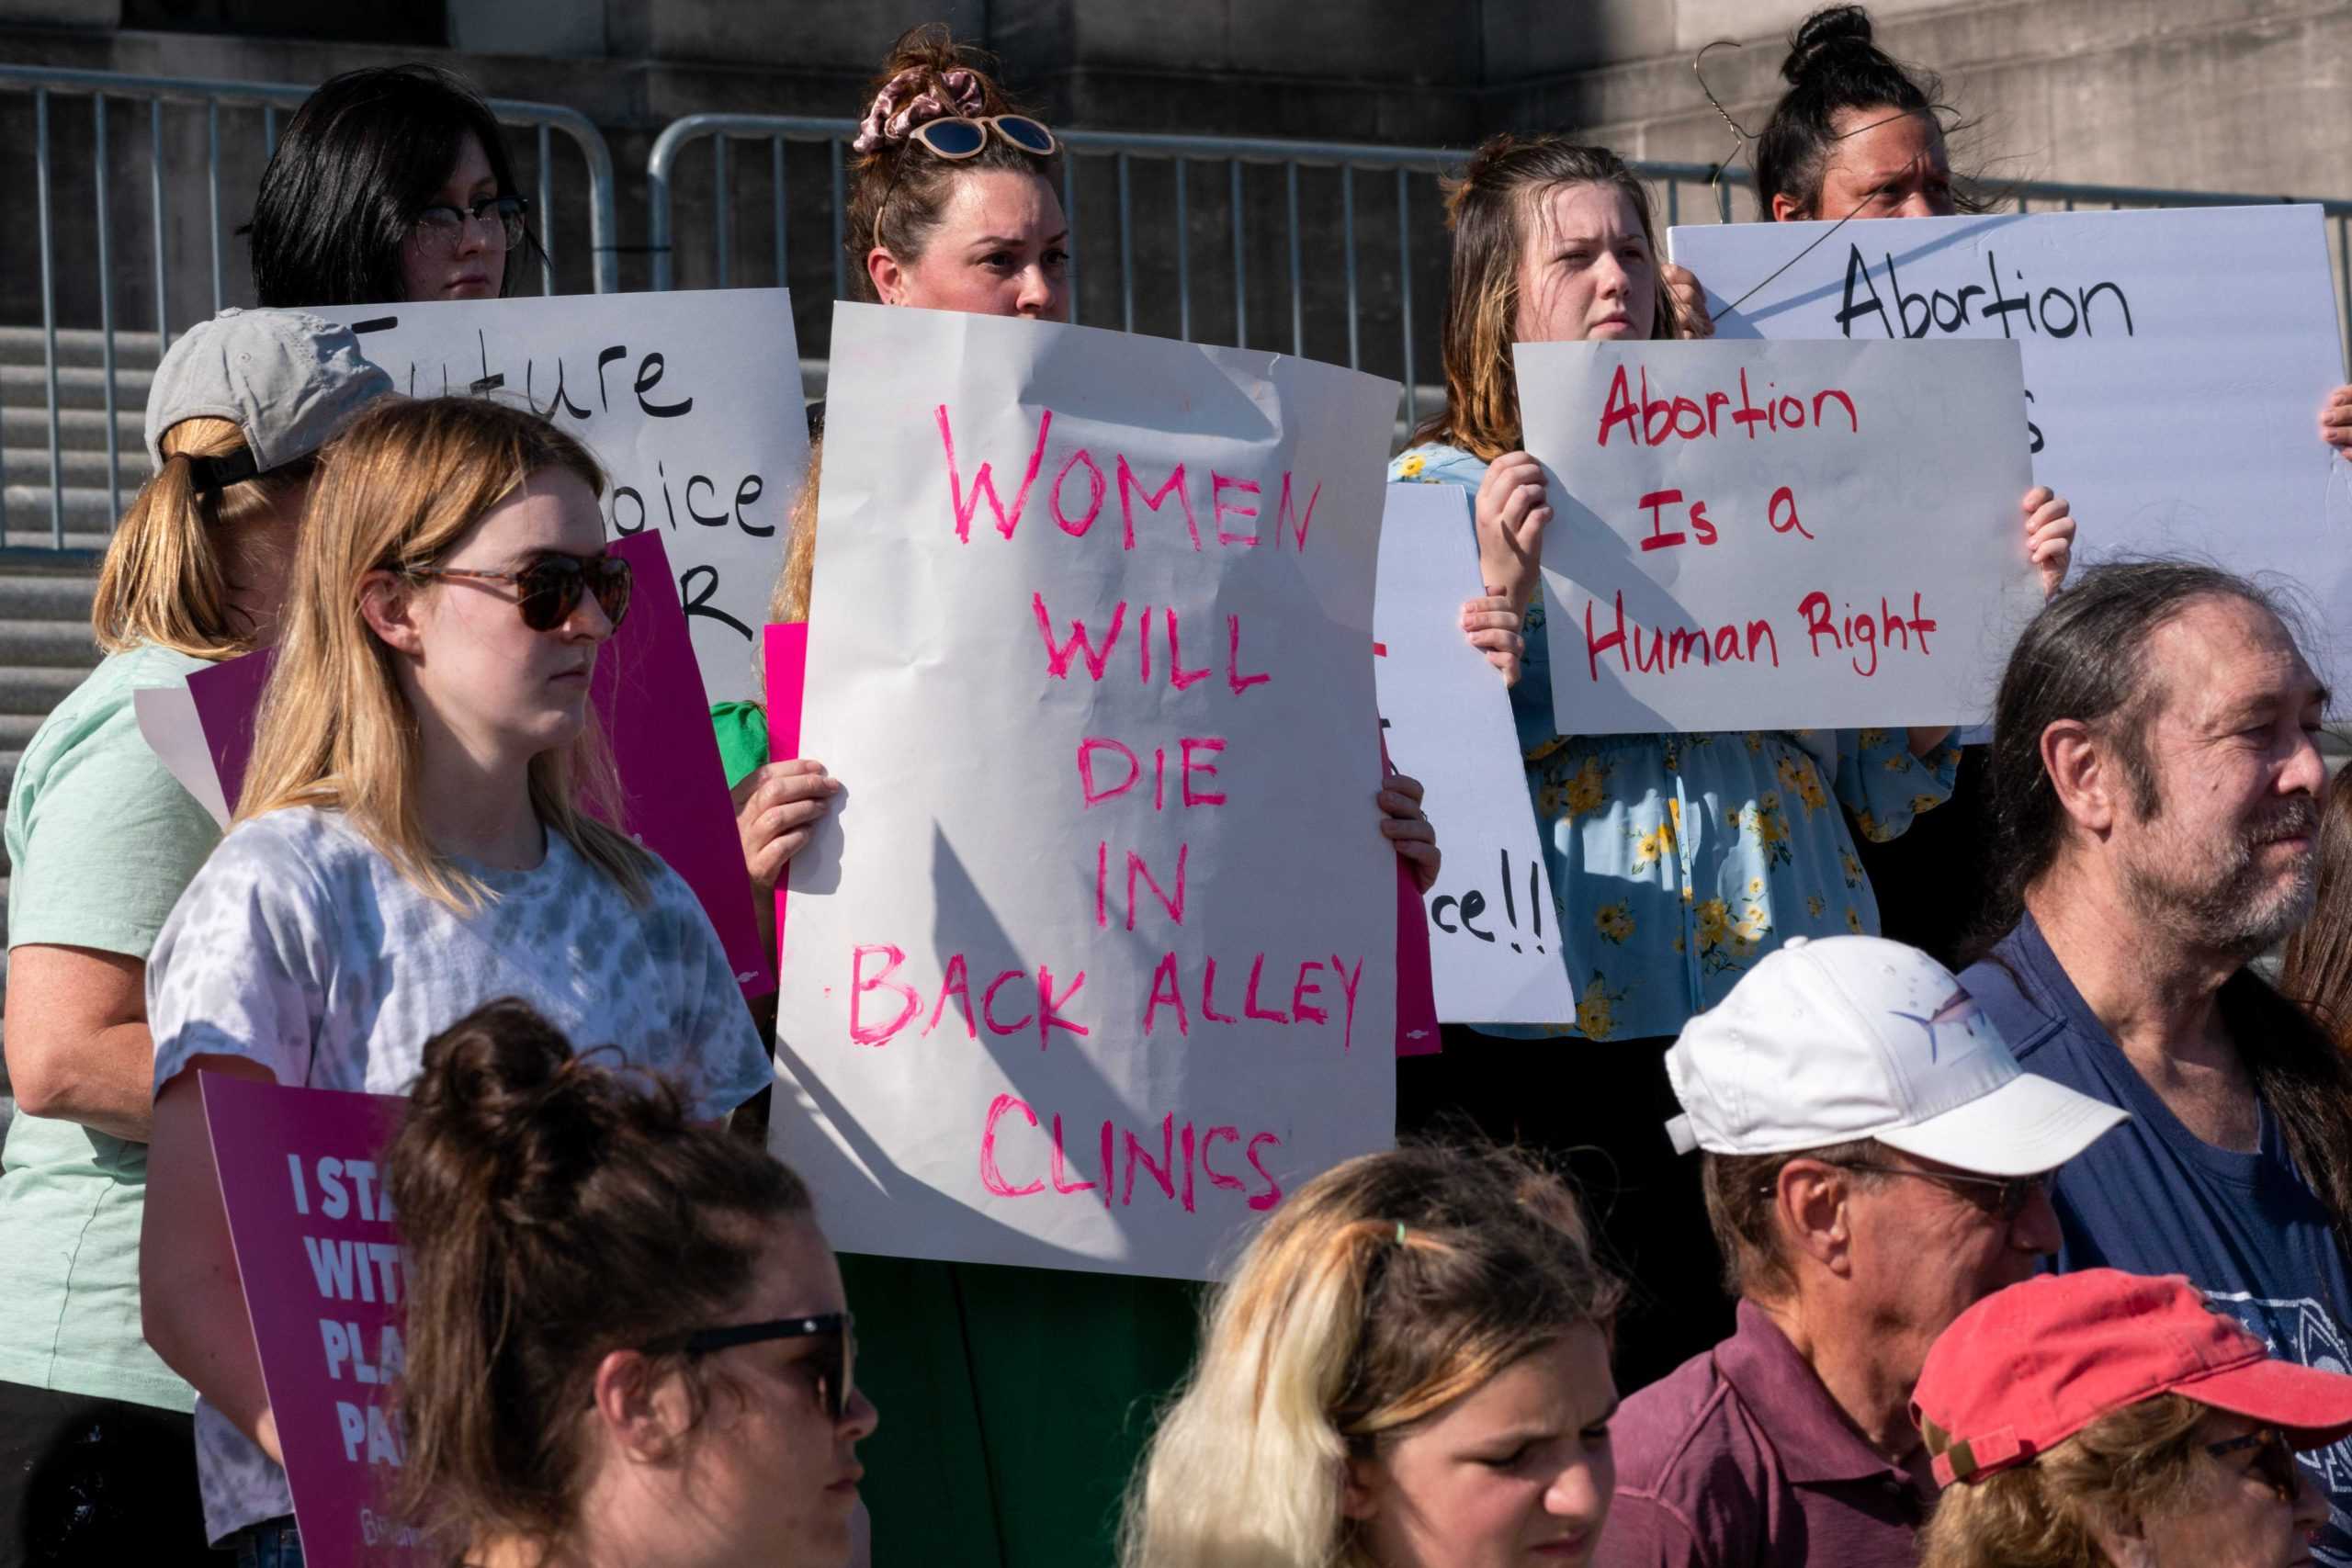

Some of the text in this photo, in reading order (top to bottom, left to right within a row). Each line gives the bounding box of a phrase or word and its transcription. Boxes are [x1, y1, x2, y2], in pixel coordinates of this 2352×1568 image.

[1836, 243, 2133, 339] Abortion
[351, 316, 693, 420] uture
[1597, 364, 1857, 446] Abortion
[612, 460, 775, 537] oice
[934, 403, 1321, 551] WOMEN
[1638, 486, 1815, 552] Is a
[1031, 591, 1271, 695] WILL
[1586, 590, 1937, 682] Human Right
[1077, 737, 1227, 812] DIE
[1095, 840, 1189, 931] IN
[849, 943, 1363, 1051] BACK ALLEY
[287, 1153, 310, 1215] I
[979, 1093, 1283, 1213] CLINICS
[302, 1235, 411, 1305] WIT
